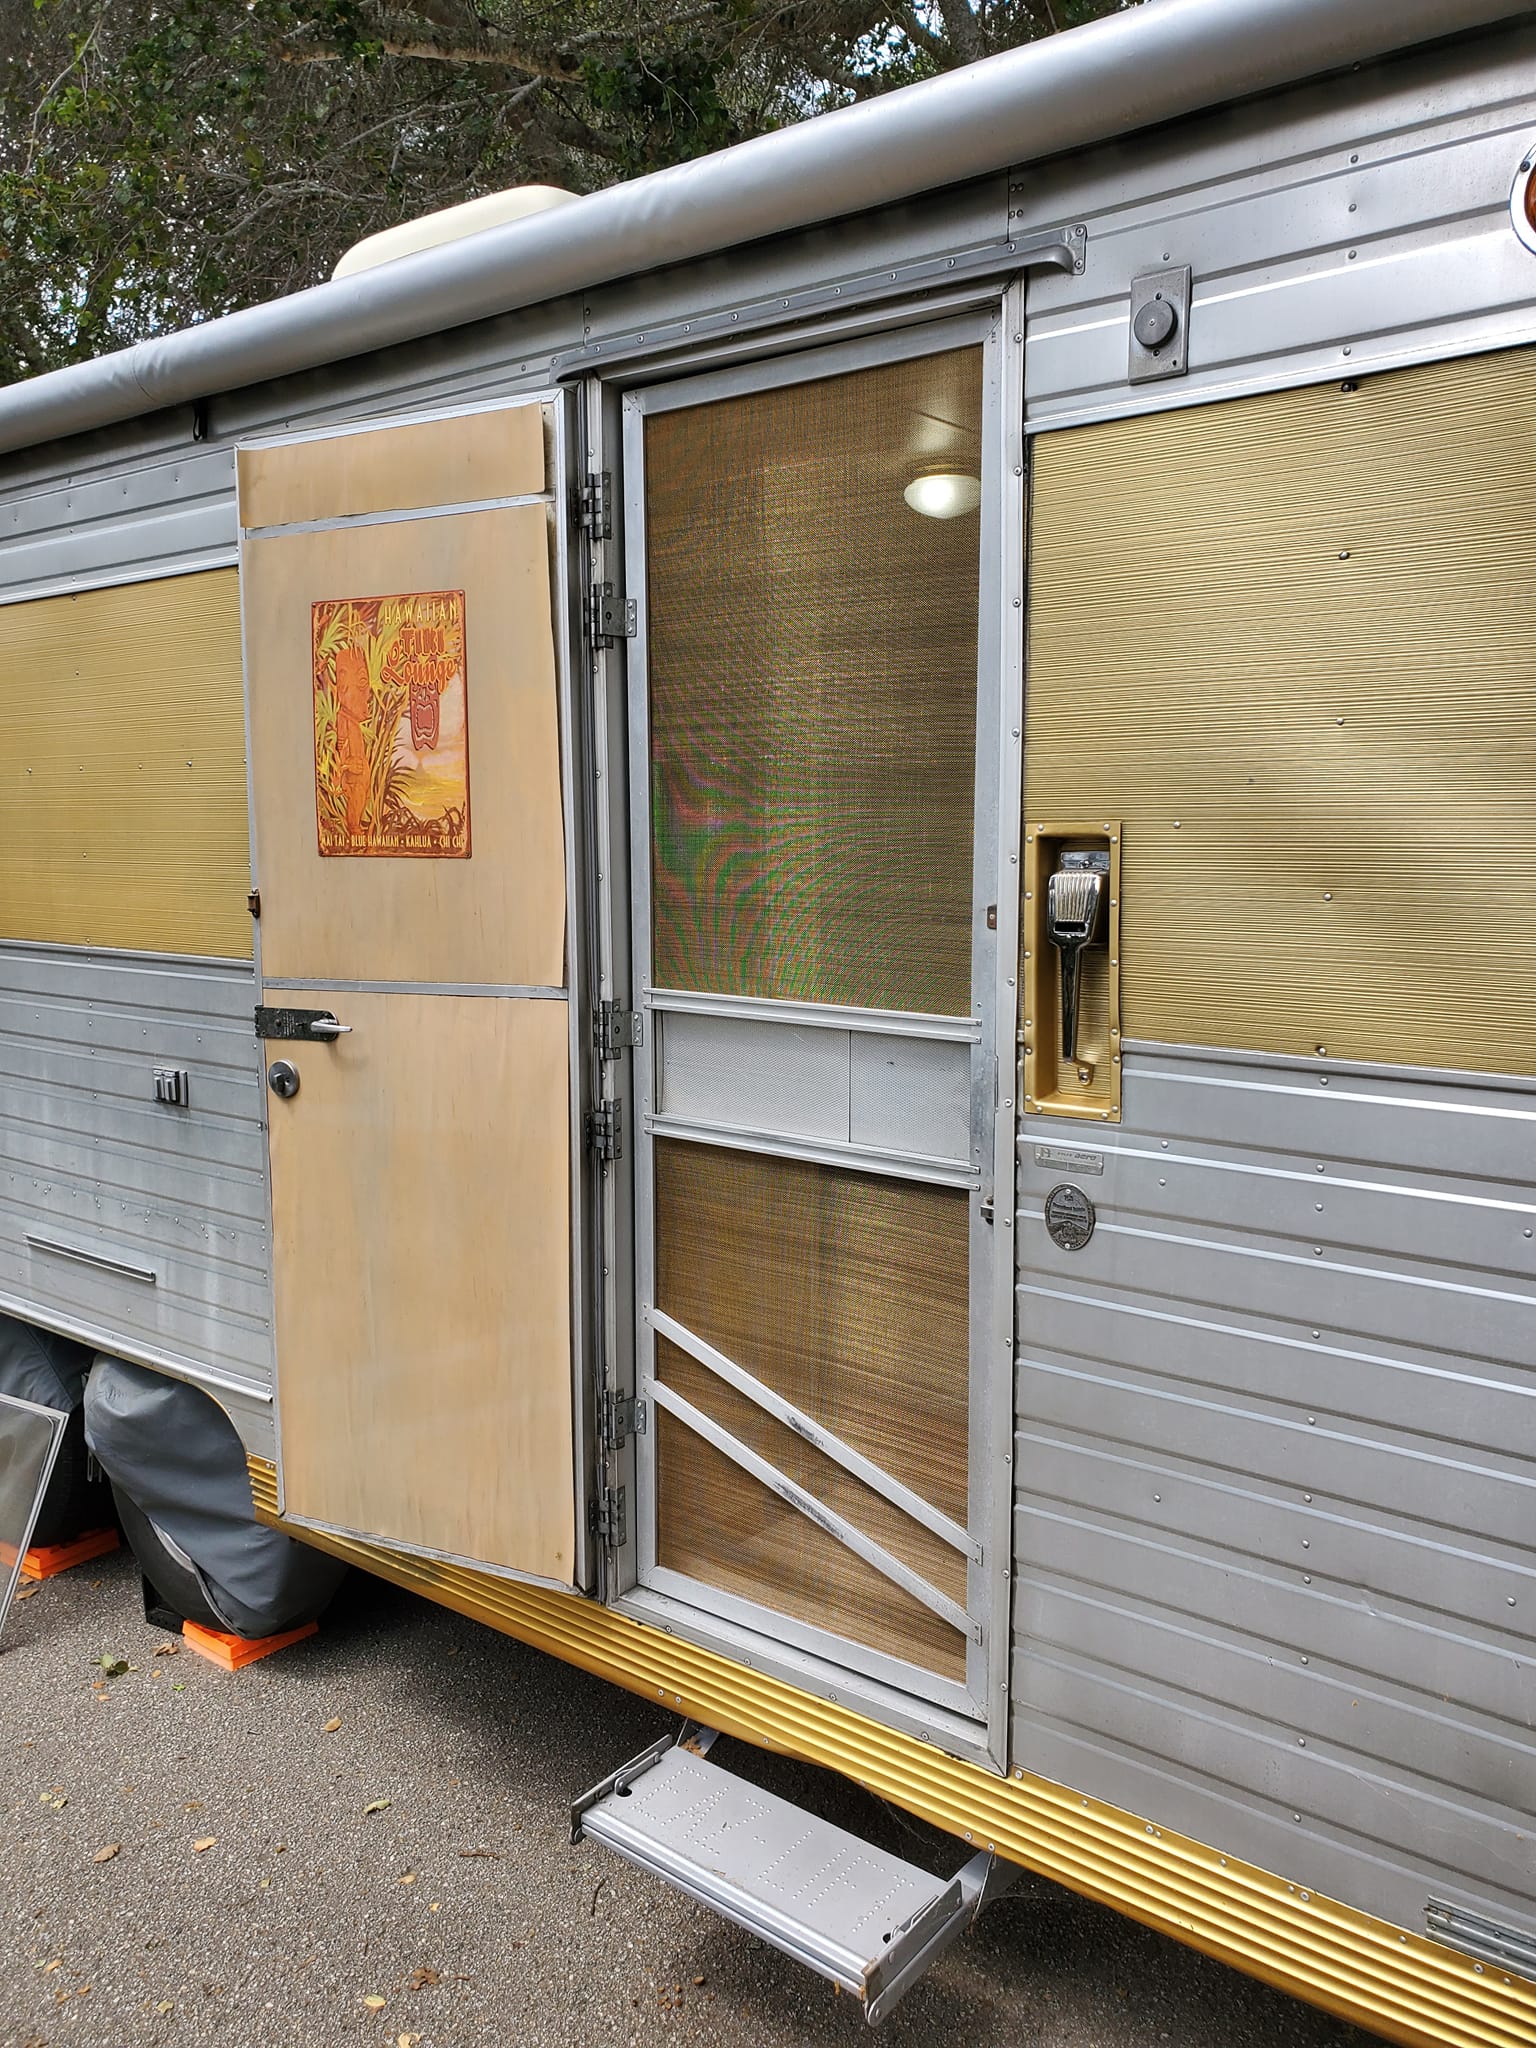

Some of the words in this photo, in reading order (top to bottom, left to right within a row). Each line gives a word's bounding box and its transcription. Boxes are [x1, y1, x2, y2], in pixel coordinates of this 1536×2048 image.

[384, 600, 457, 624] HAWAIIAN
[400, 627, 446, 658] TIKI
[381, 640, 456, 694] Lounge
[334, 834, 345, 847] TAI
[351, 834, 367, 847] BLUE
[367, 834, 399, 848] HAWAIIAN
[405, 834, 432, 848] KAHLUA
[439, 834, 451, 848] CHI
